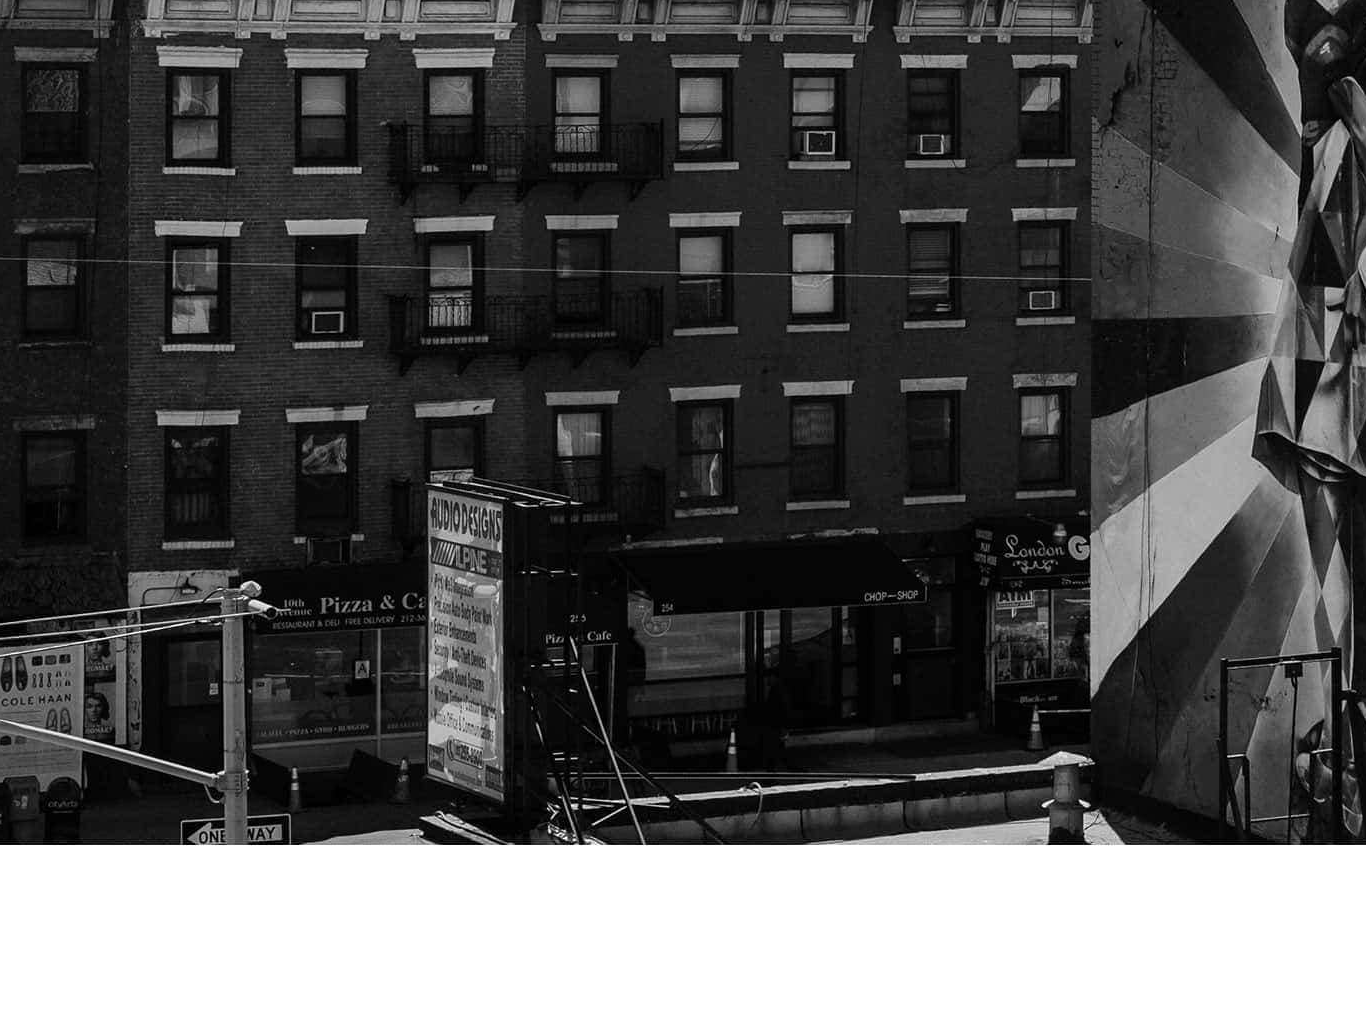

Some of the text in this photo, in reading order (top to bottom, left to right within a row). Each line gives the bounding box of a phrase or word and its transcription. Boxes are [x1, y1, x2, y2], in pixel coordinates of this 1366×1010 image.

[431, 498, 502, 543] AUDIO DESIGNS
[1003, 534, 1066, 558] London
[284, 598, 305, 608] 10th
[319, 596, 373, 615] Pizza
[380, 594, 395, 610] &
[272, 619, 316, 630] RESTAURANT
[325, 617, 341, 628] DELI
[344, 617, 362, 627] FREE
[363, 615, 395, 626] DELIVERY
[587, 630, 612, 642] Cafe
[357, 663, 367, 675] A
[1, 694, 72, 707] COLE HAAN
[199, 830, 226, 844] ONE
